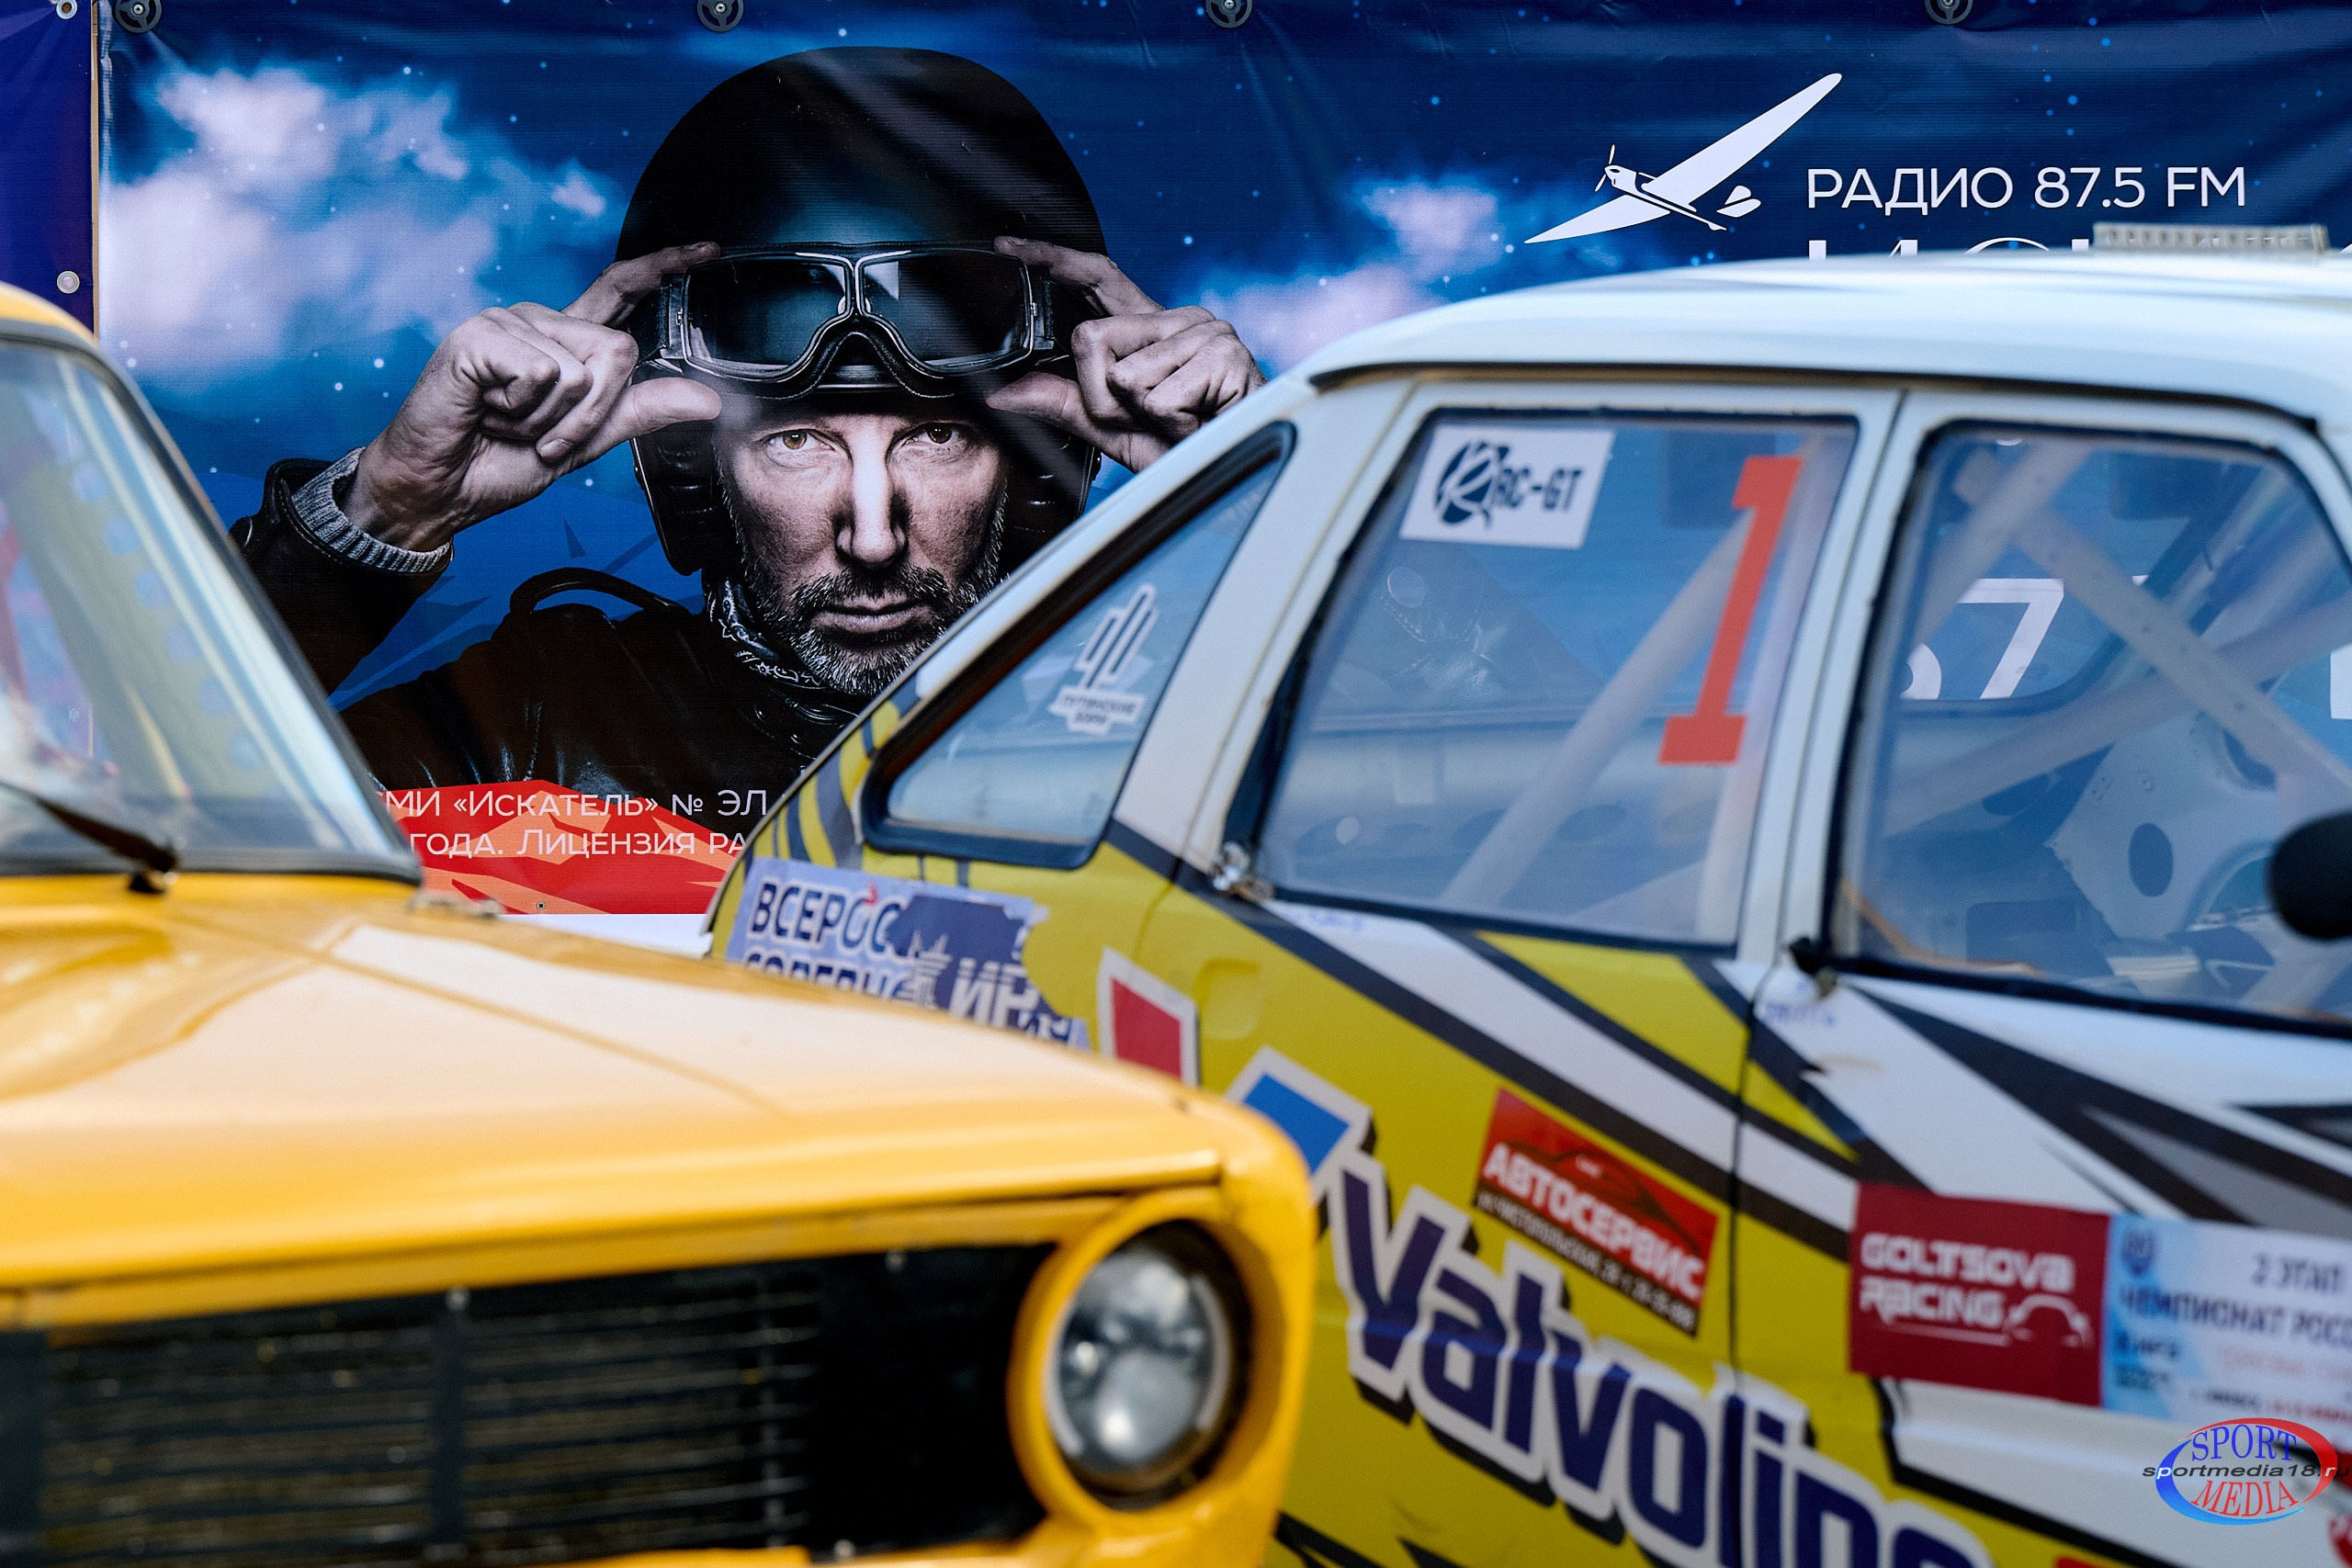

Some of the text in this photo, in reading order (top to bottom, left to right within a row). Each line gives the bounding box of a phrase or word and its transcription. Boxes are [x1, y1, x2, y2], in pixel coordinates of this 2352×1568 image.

[1807, 166, 2246, 216] РАДИО 87.5 FM
[1657, 455, 1804, 766] 1
[377, 790, 440, 817] МИ
[672, 794, 704, 816] №
[718, 789, 766, 816] ЭЛ
[410, 833, 503, 859] ГОДА.
[1481, 1142, 1707, 1301] АВТОСЕРВИС
